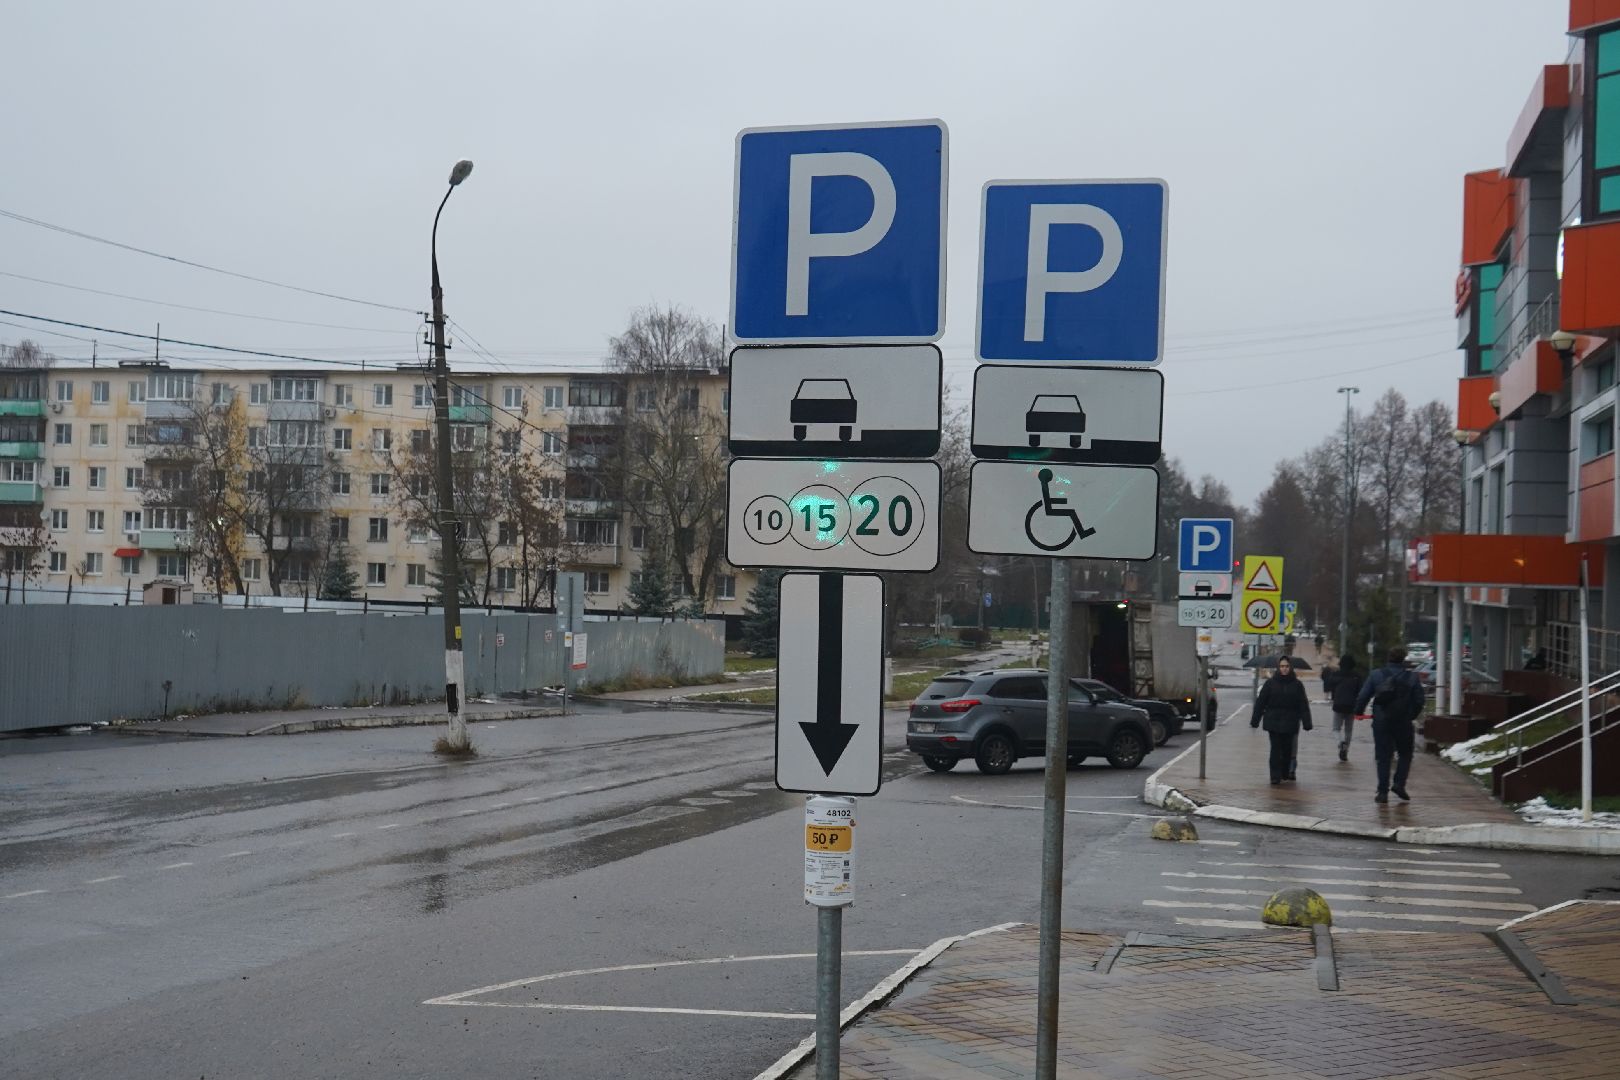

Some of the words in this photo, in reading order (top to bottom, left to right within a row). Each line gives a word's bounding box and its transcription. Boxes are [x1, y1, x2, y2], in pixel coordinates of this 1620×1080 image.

[785, 152, 897, 316] P
[1024, 203, 1124, 342] P
[753, 509, 783, 532] 10
[800, 505, 837, 533] 15
[855, 495, 913, 537] 20
[1192, 525, 1221, 566] P
[1196, 610, 1206, 618] 15
[1210, 608, 1225, 619] 20
[1253, 608, 1268, 620] 40
[812, 832, 827, 845] 50
